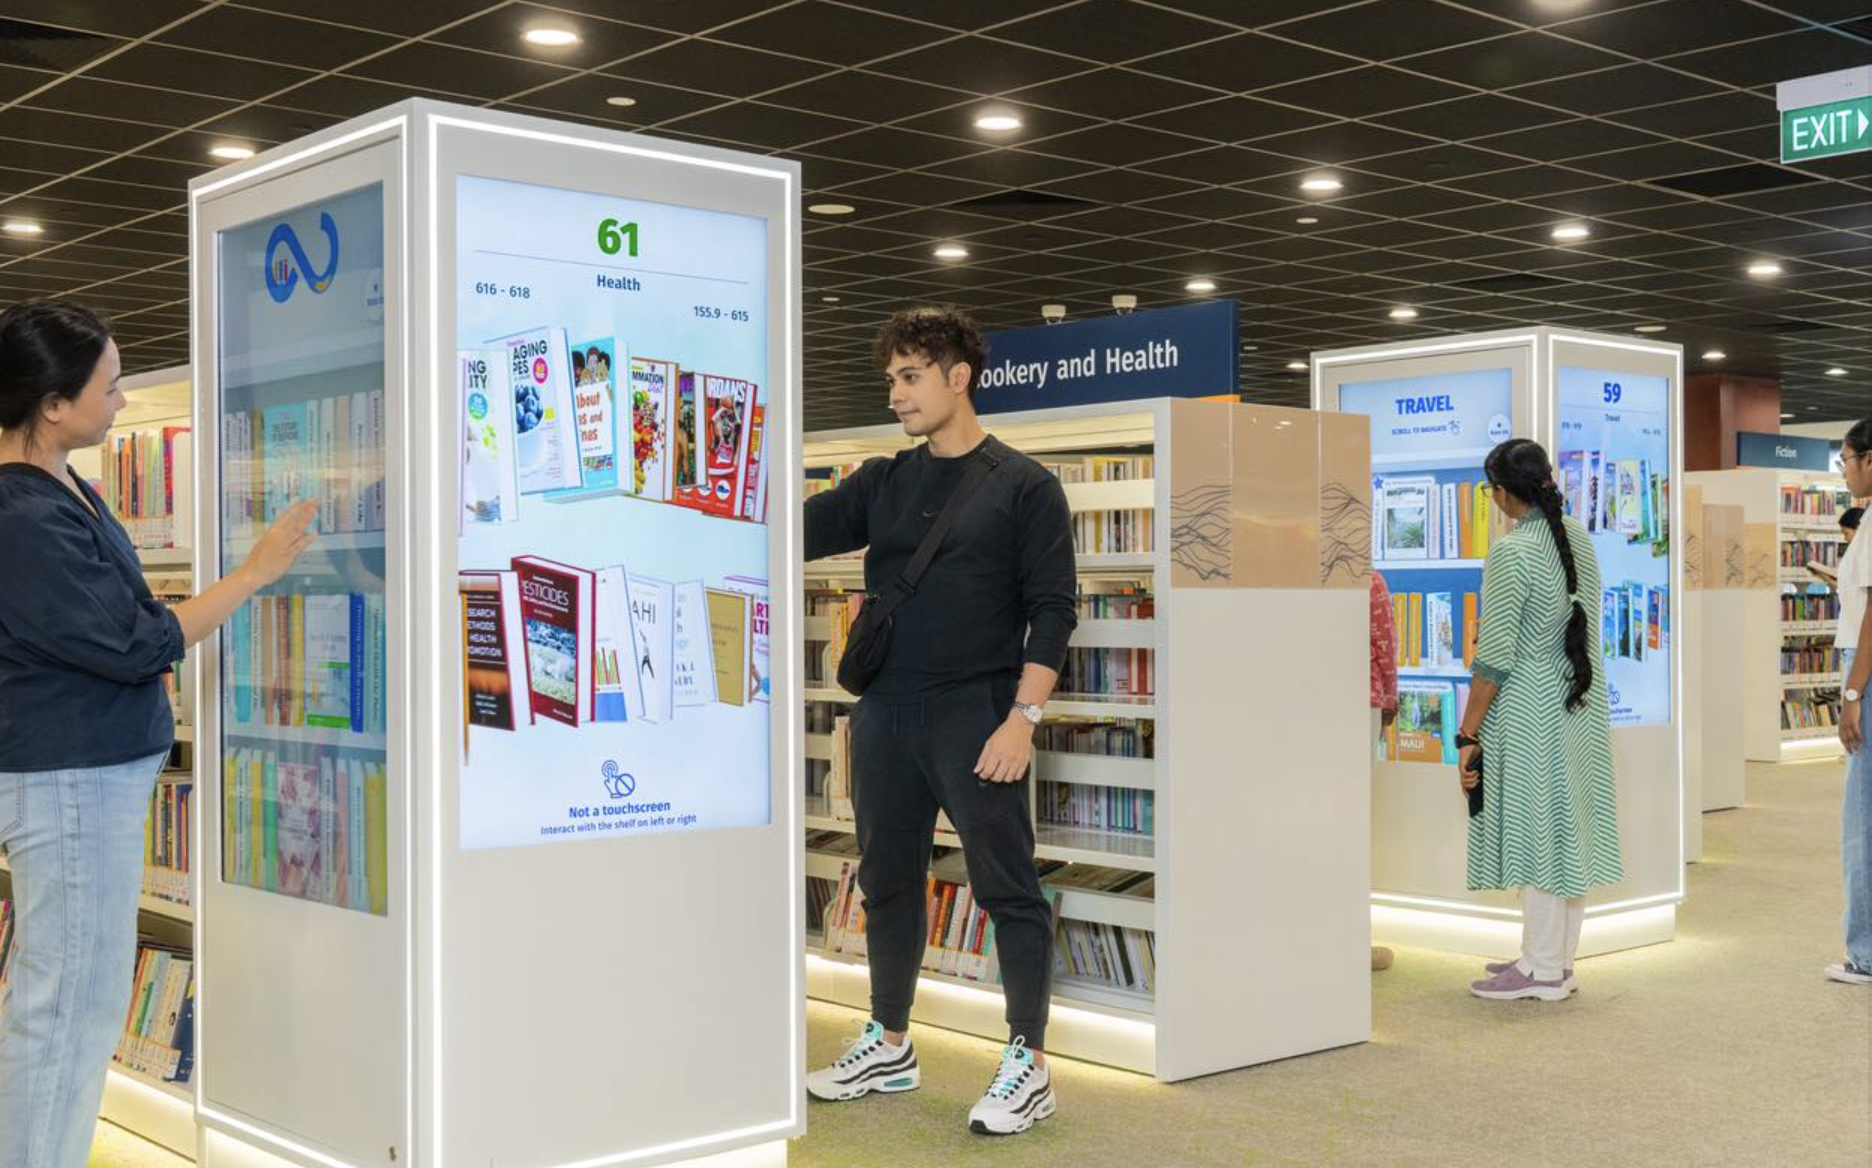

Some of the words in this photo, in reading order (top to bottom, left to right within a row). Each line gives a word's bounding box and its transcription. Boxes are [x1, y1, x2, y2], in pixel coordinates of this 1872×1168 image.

[1792, 110, 1852, 151] EXIT
[597, 218, 639, 256] 61
[475, 283, 497, 295] 616
[509, 285, 531, 299] 618
[596, 274, 641, 291] Health
[693, 306, 721, 318] 155.9
[731, 309, 749, 322] 615
[977, 359, 1049, 390] ookery
[1057, 348, 1096, 380] and
[1106, 339, 1178, 374] Health
[468, 375, 488, 388] ITY
[1603, 382, 1621, 403] 59
[1396, 395, 1454, 414] TRAVEL
[1776, 446, 1797, 458] Fiction
[521, 580, 569, 605] ESTICIDES
[569, 807, 589, 818] Not
[593, 807, 599, 816] a
[603, 801, 671, 815] touchscreen
[541, 824, 575, 835] Interact
[577, 822, 596, 832] with
[598, 822, 612, 830] the
[615, 819, 635, 828] shelf
[638, 819, 648, 827] on
[650, 817, 664, 826] left
[677, 815, 697, 825] right
